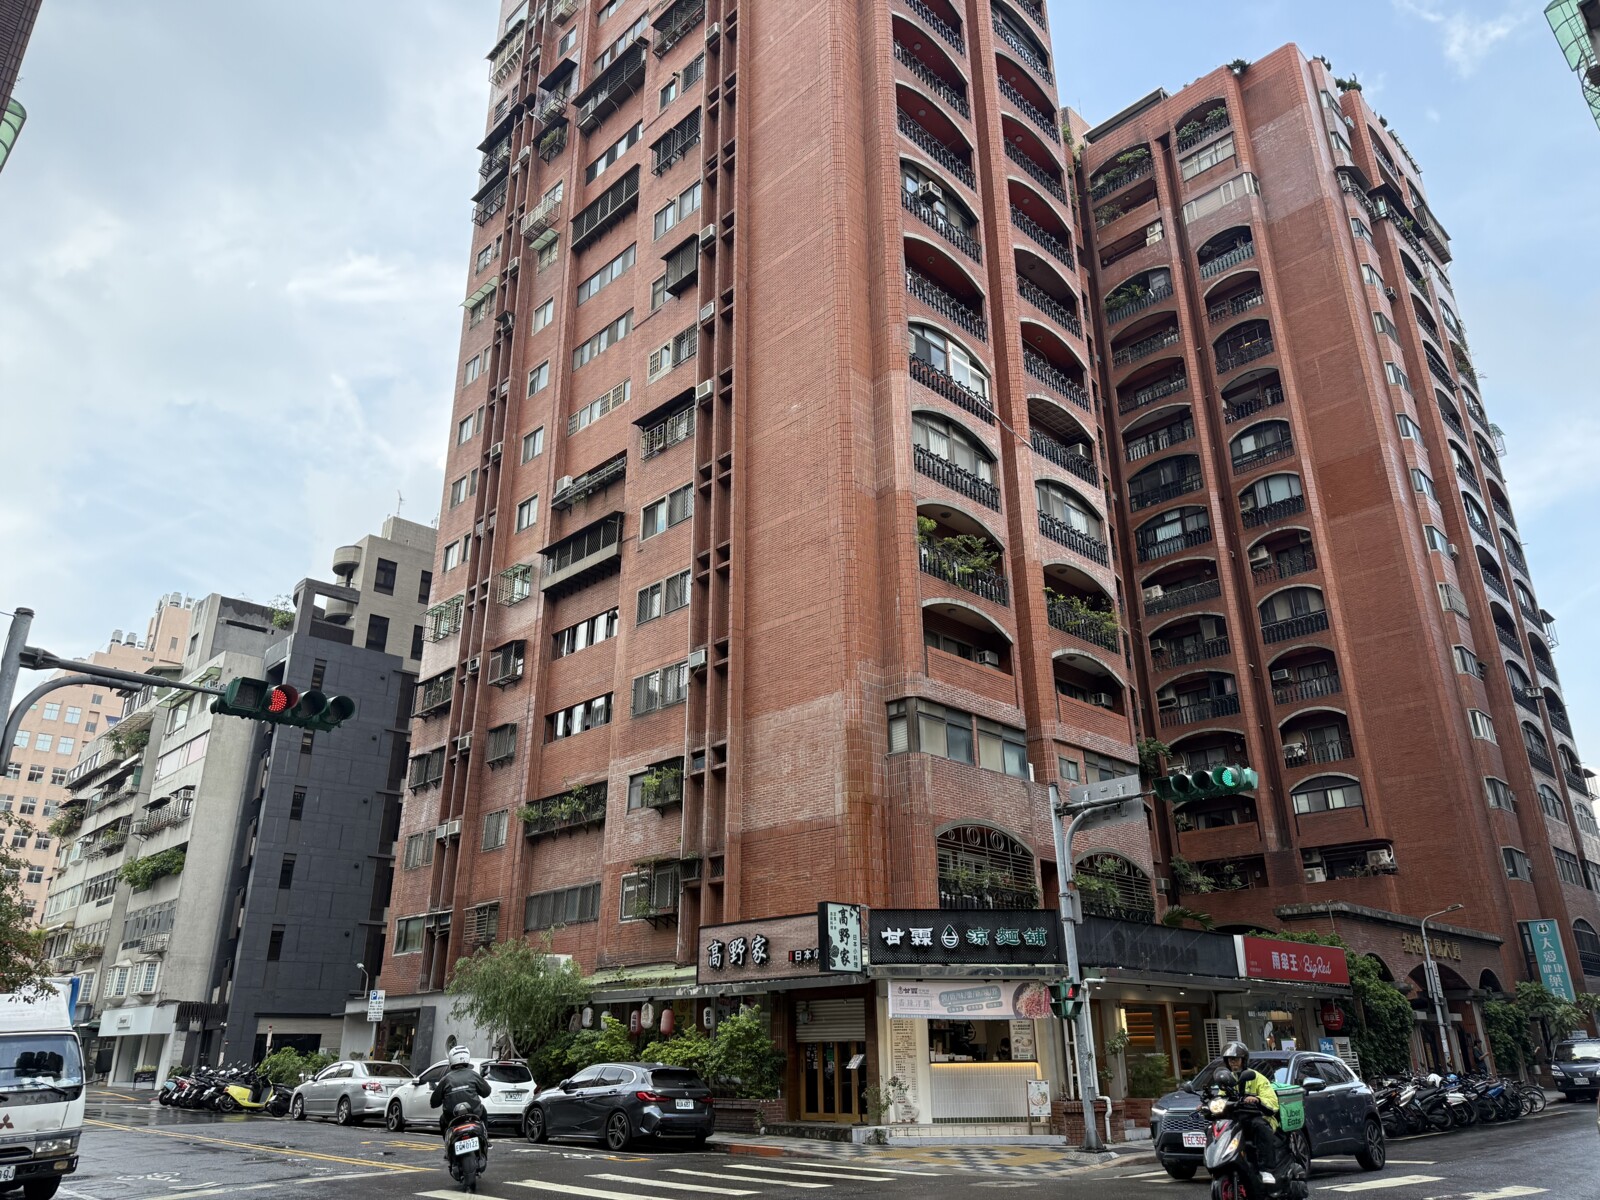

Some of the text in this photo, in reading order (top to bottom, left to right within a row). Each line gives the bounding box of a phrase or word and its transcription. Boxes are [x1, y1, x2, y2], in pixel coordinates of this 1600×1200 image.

[881, 927, 934, 946] 甘霖
[1271, 951, 1299, 972] 雨傘王
[1286, 1108, 1300, 1117] Uber
[1287, 1117, 1301, 1126] Eats
